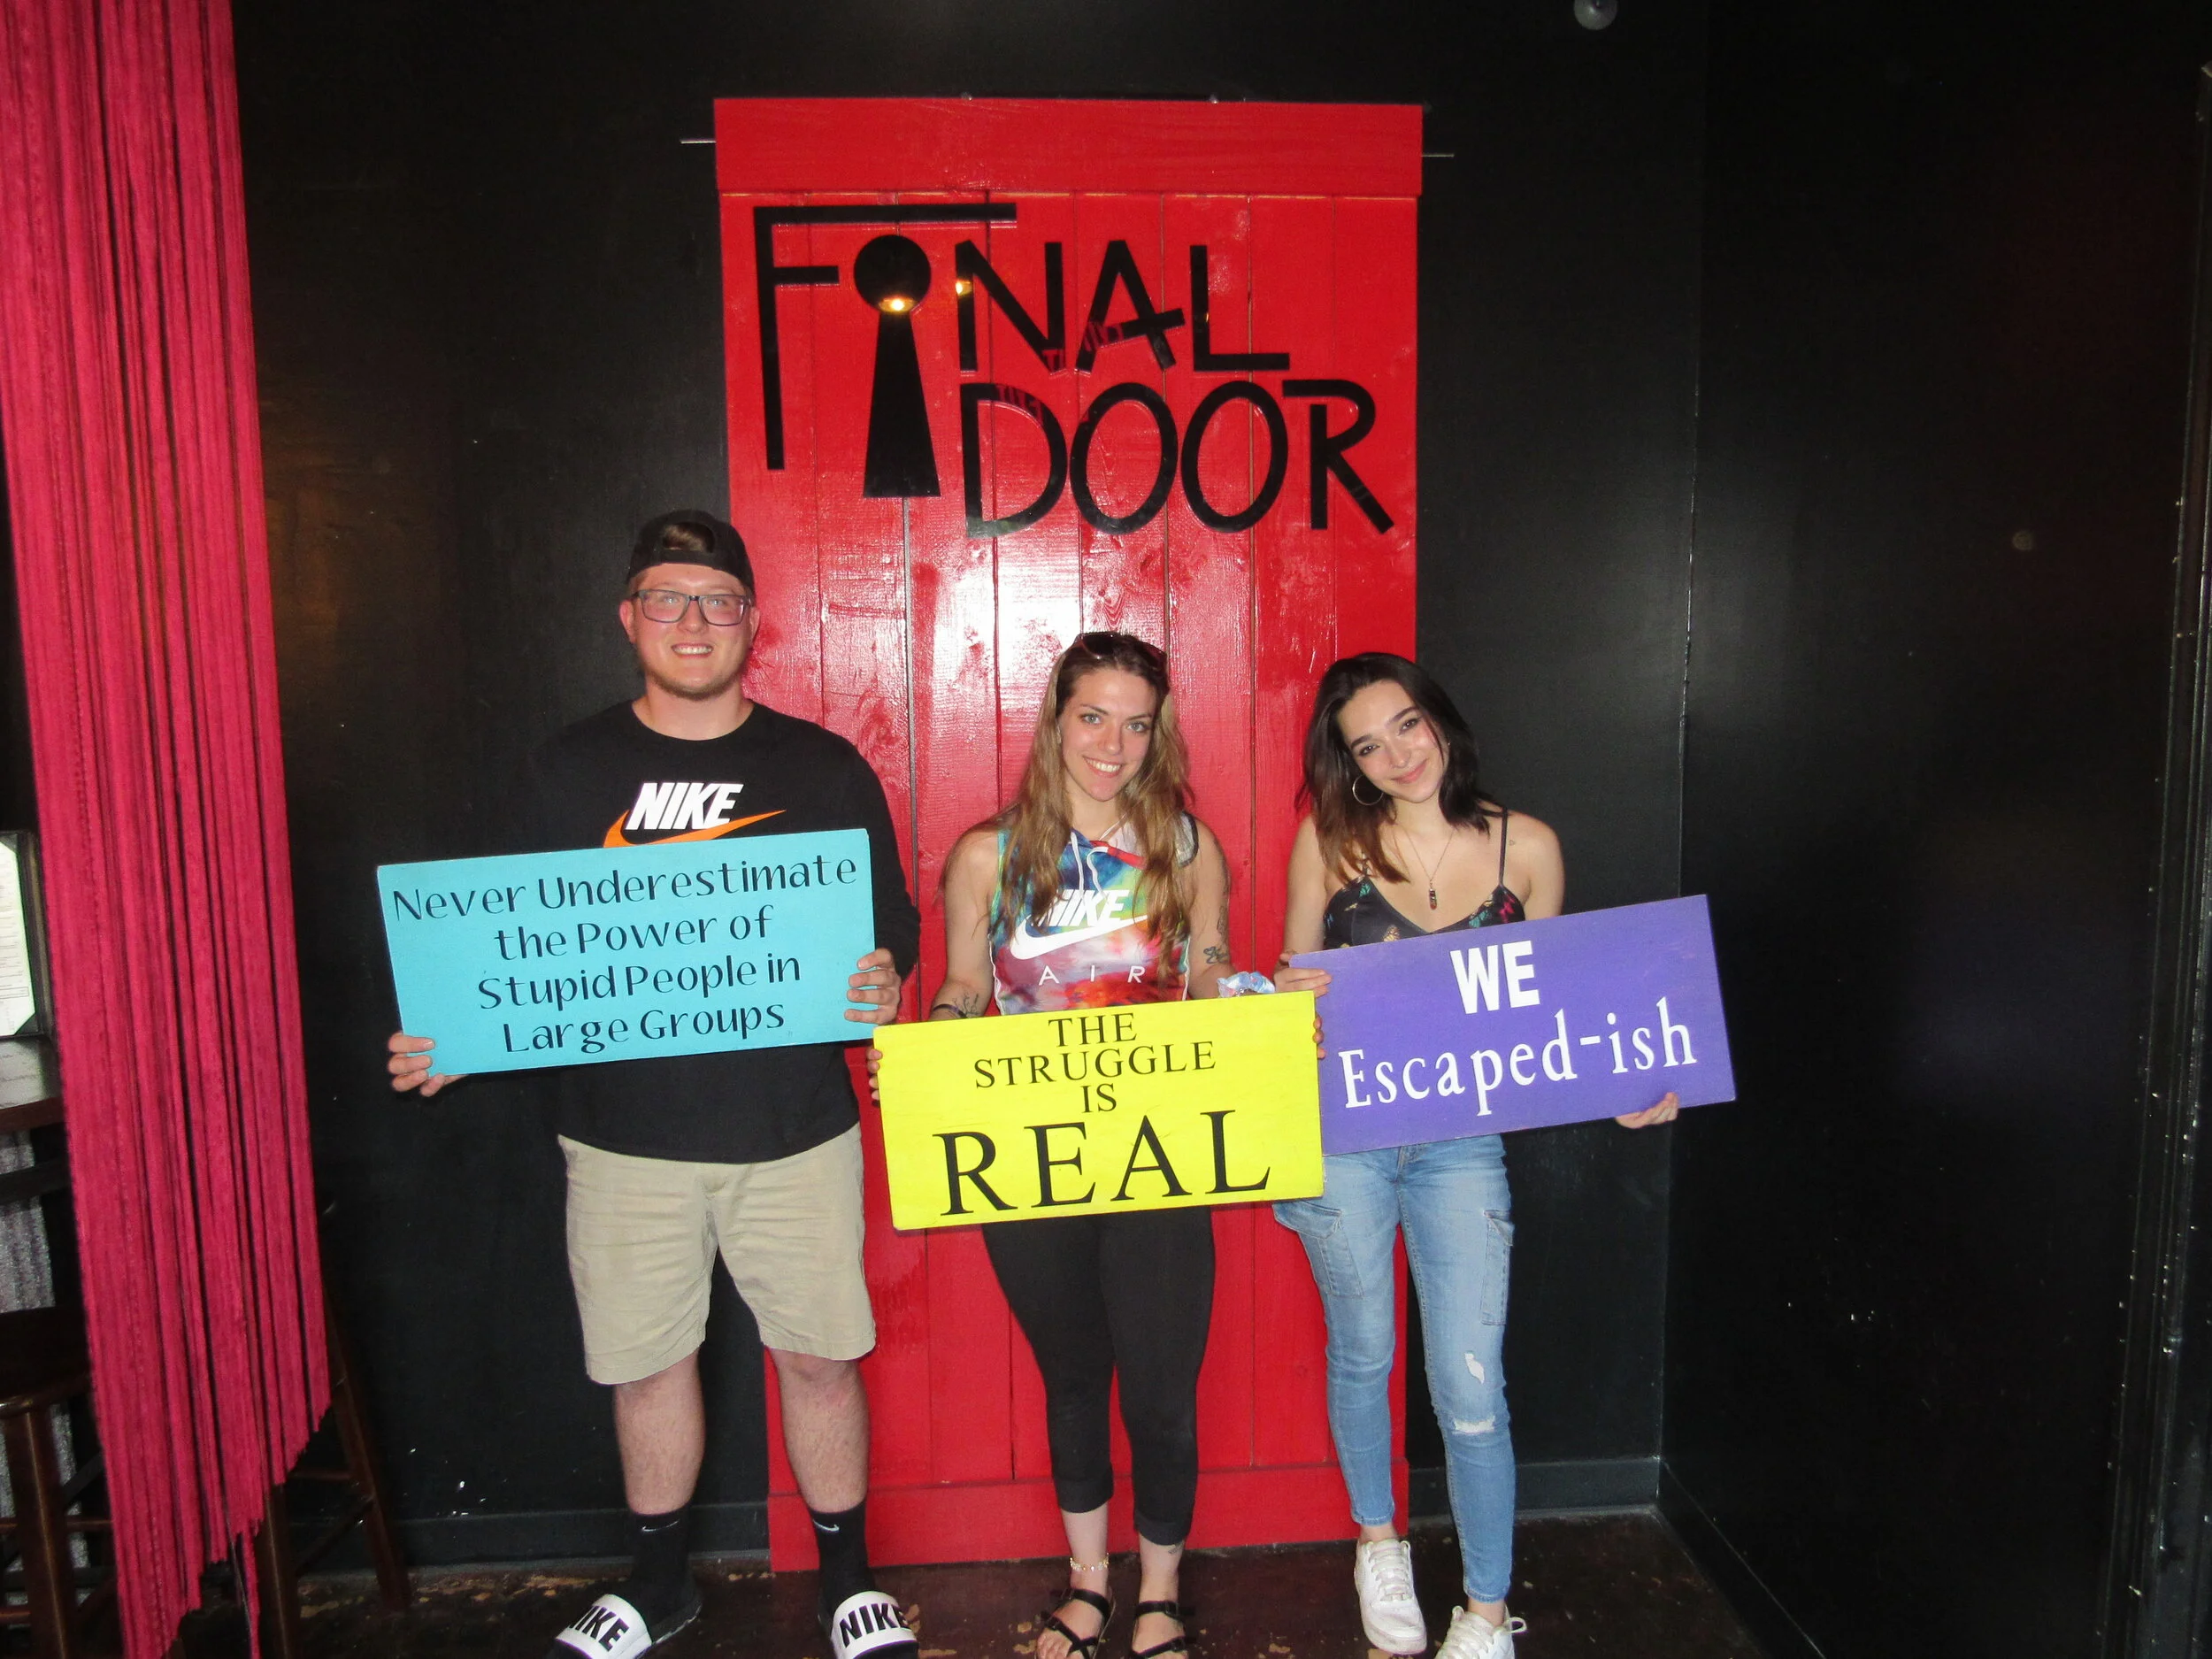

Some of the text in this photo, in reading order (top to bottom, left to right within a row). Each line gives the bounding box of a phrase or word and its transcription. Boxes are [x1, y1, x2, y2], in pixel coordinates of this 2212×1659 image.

[959, 379, 1394, 537] DOOR
[626, 782, 743, 830] NIKE
[394, 855, 856, 921] Never Underestimate
[495, 905, 774, 961] the Power of
[478, 953, 801, 1011] Stupid People in
[1039, 965, 1146, 986] AIR
[1450, 941, 1540, 1015] WE
[503, 1003, 785, 1054] Large Groups
[1048, 1013, 1137, 1048] THE
[974, 1041, 1216, 1088] STRUGGLE
[1338, 997, 1697, 1117] Escaped-ish
[1081, 1083, 1117, 1113] IS
[933, 1110, 1271, 1216] REAL
